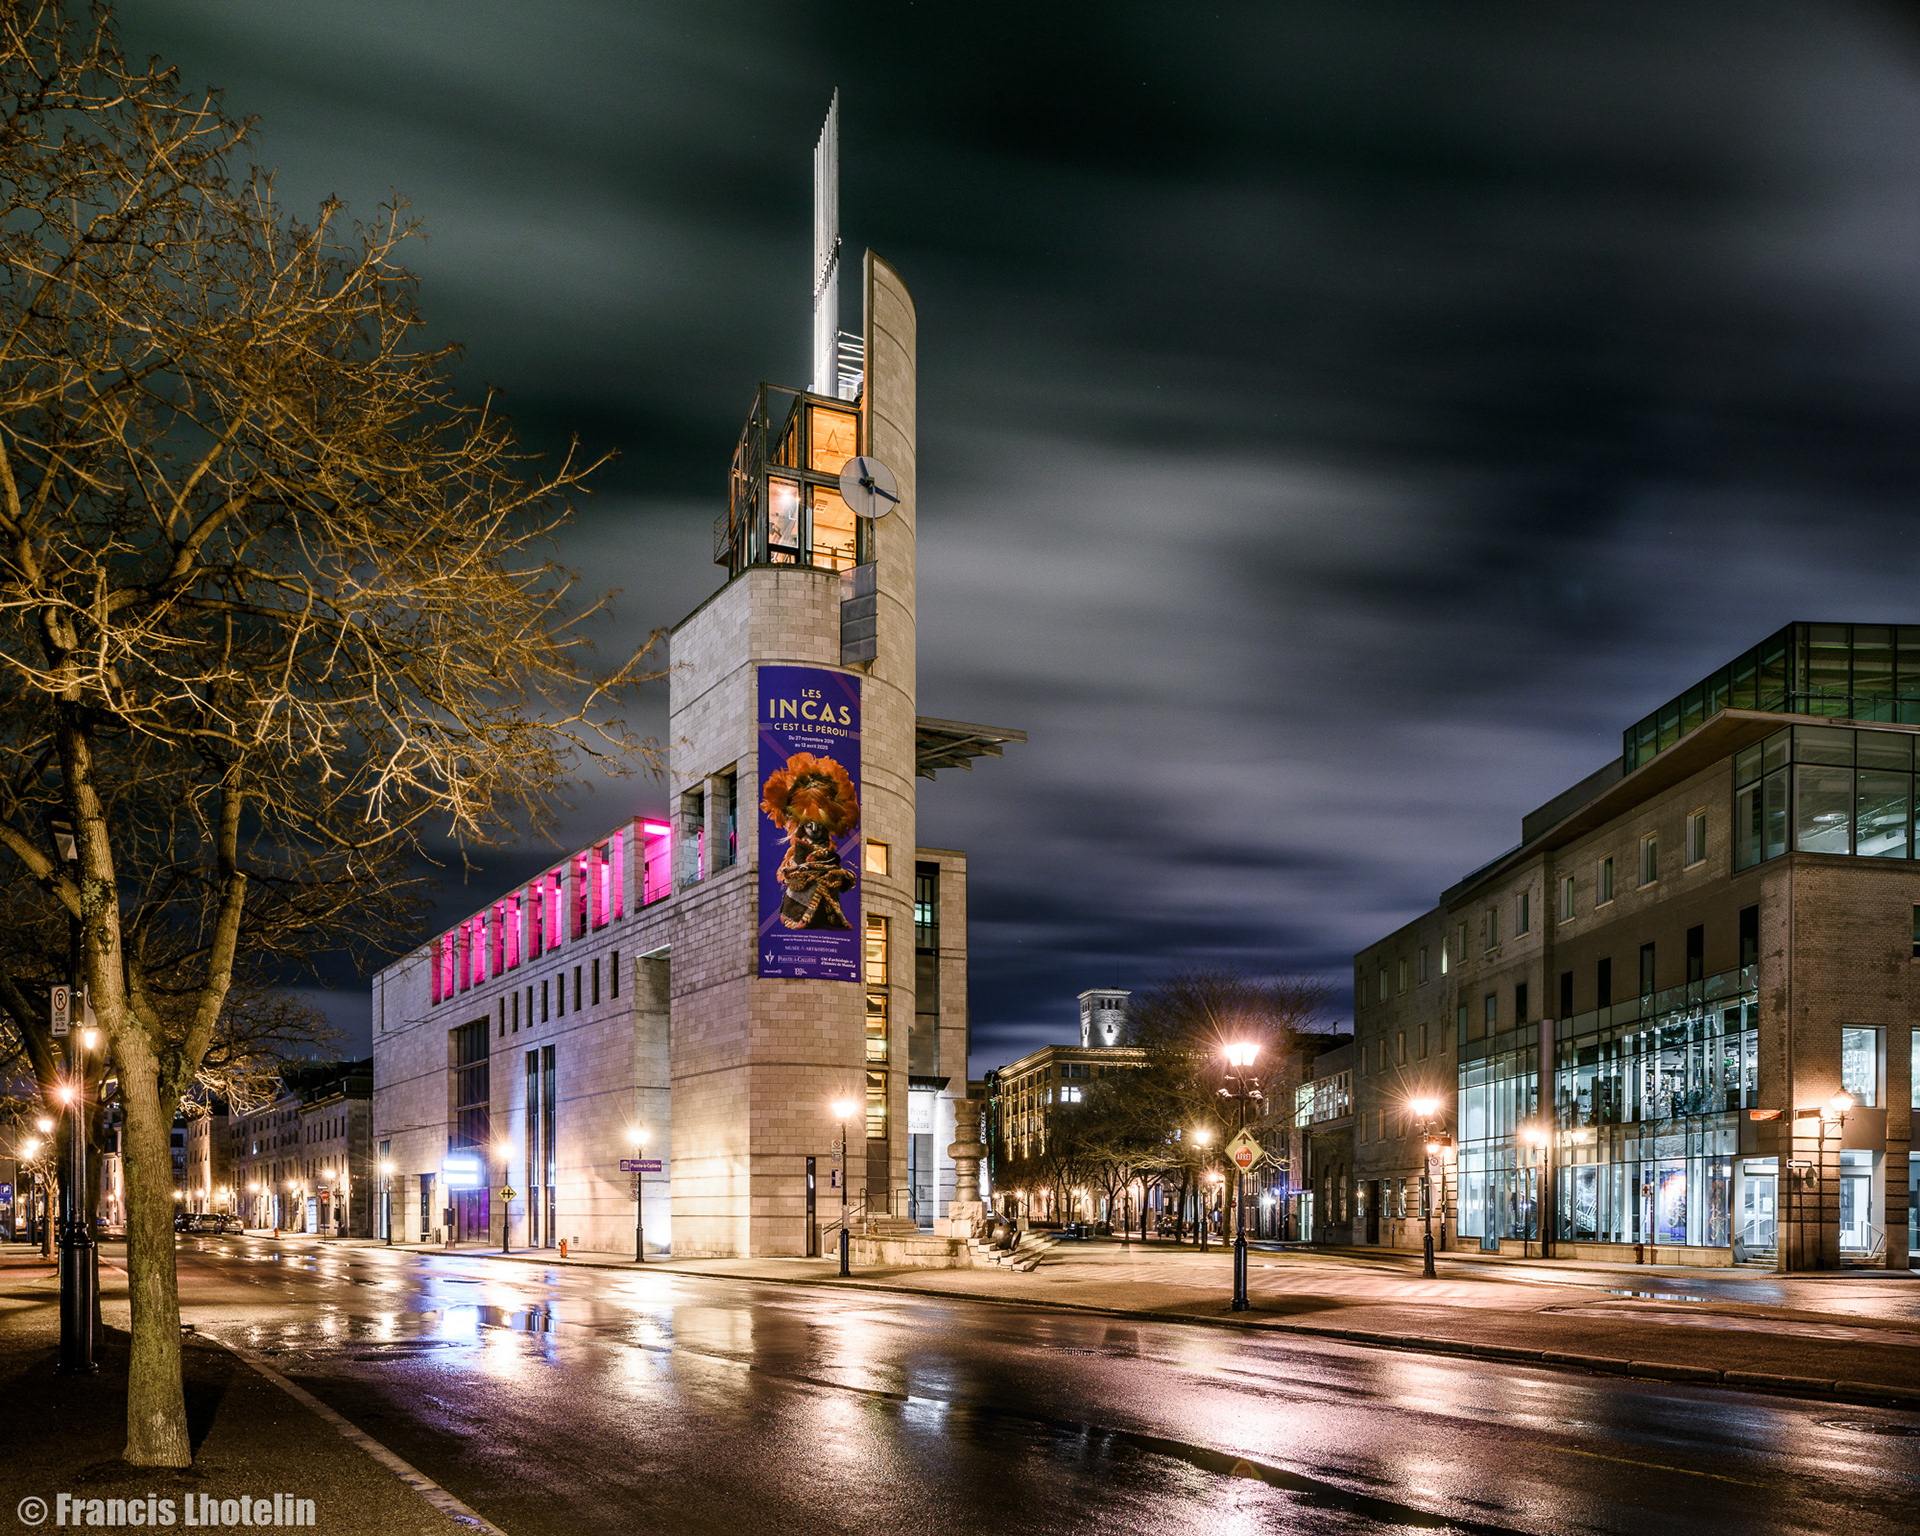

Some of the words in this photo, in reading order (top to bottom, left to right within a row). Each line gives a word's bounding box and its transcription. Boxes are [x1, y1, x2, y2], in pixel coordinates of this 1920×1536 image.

[802, 688, 822, 698] LES
[770, 698, 852, 726] INCAS
[774, 722, 798, 730] C'EST
[802, 724, 812, 732] LE
[816, 725, 848, 738] PÉROU!
